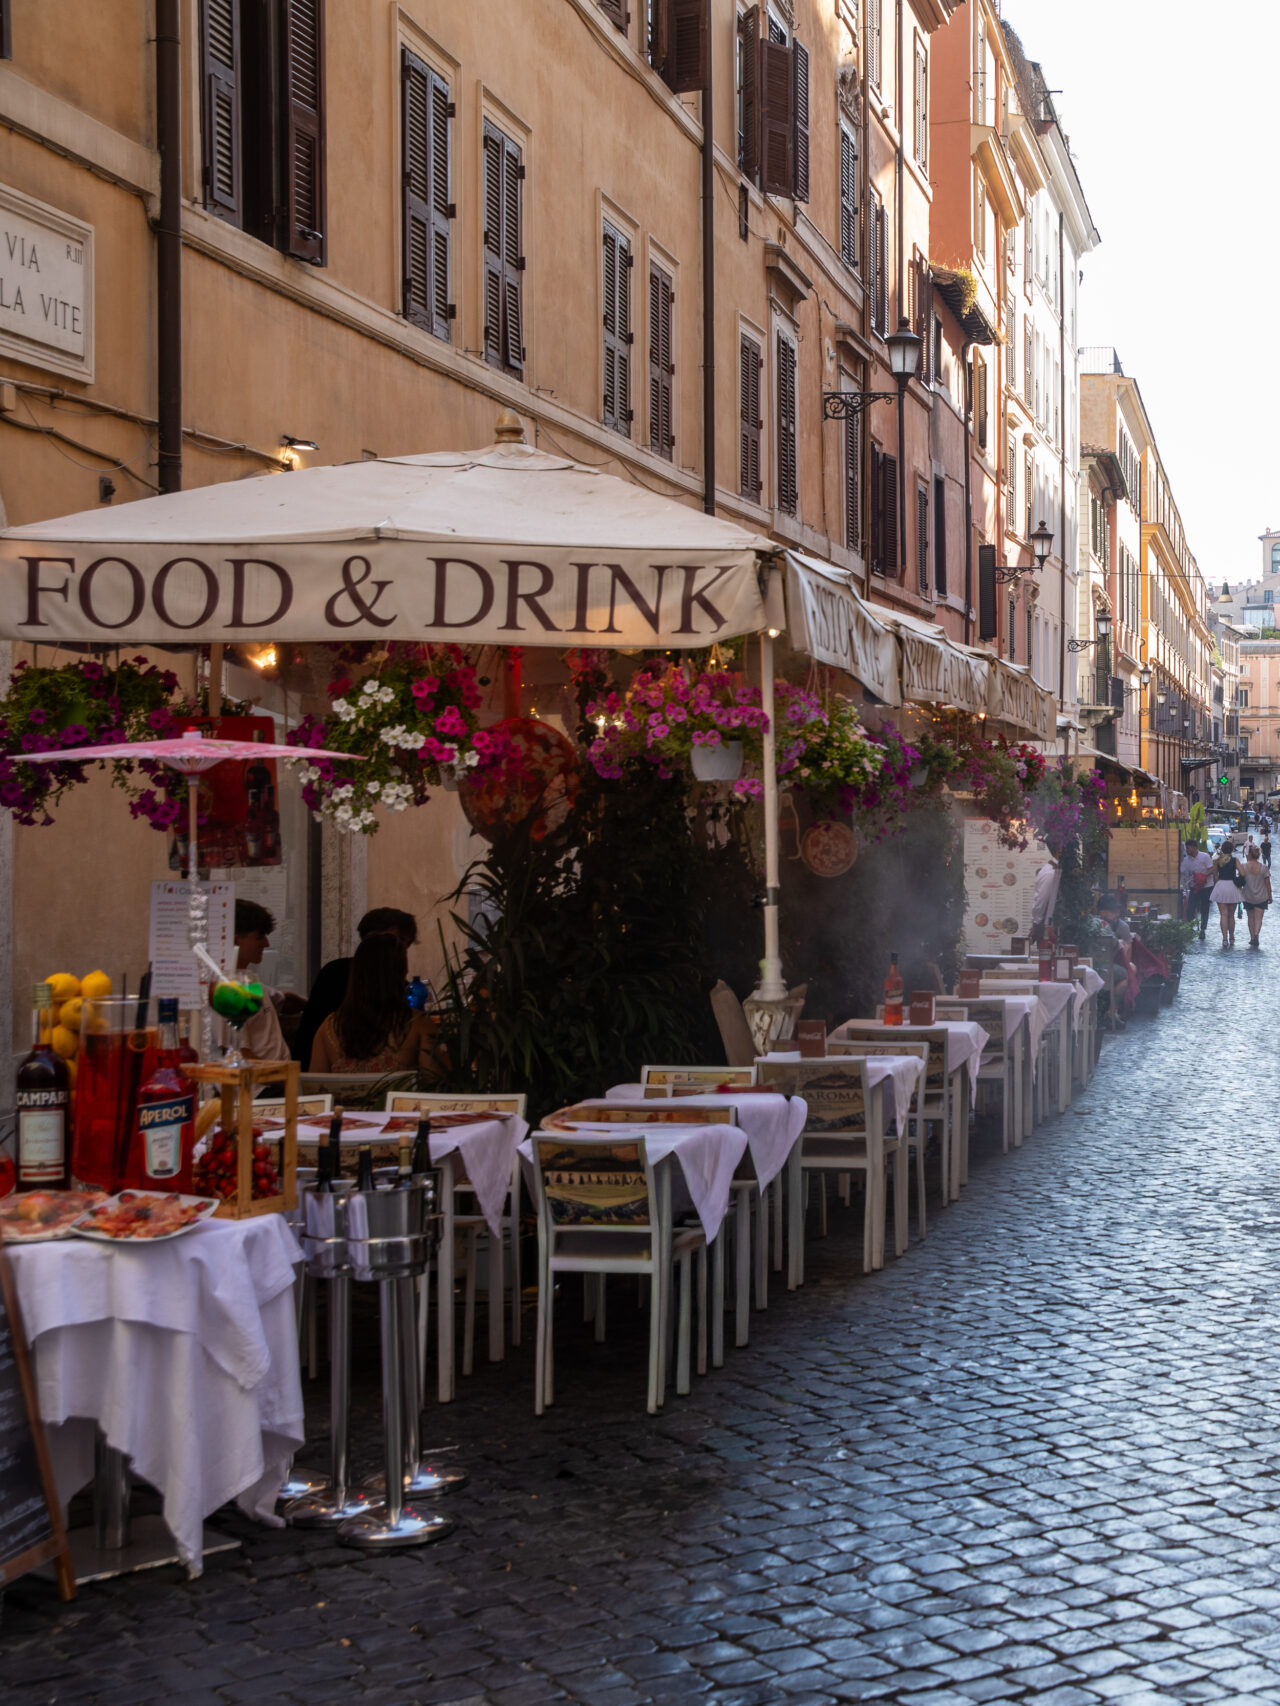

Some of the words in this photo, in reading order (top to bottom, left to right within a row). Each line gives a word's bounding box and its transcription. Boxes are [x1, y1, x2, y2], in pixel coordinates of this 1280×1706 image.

[5, 231, 40, 273] VIA
[40, 293, 82, 335] VITE
[17, 553, 295, 631] FOOD
[323, 554, 398, 629] &
[425, 555, 740, 636] DRINK
[16, 1091, 67, 1106] CAMPAR
[140, 1105, 189, 1126] APEROL
